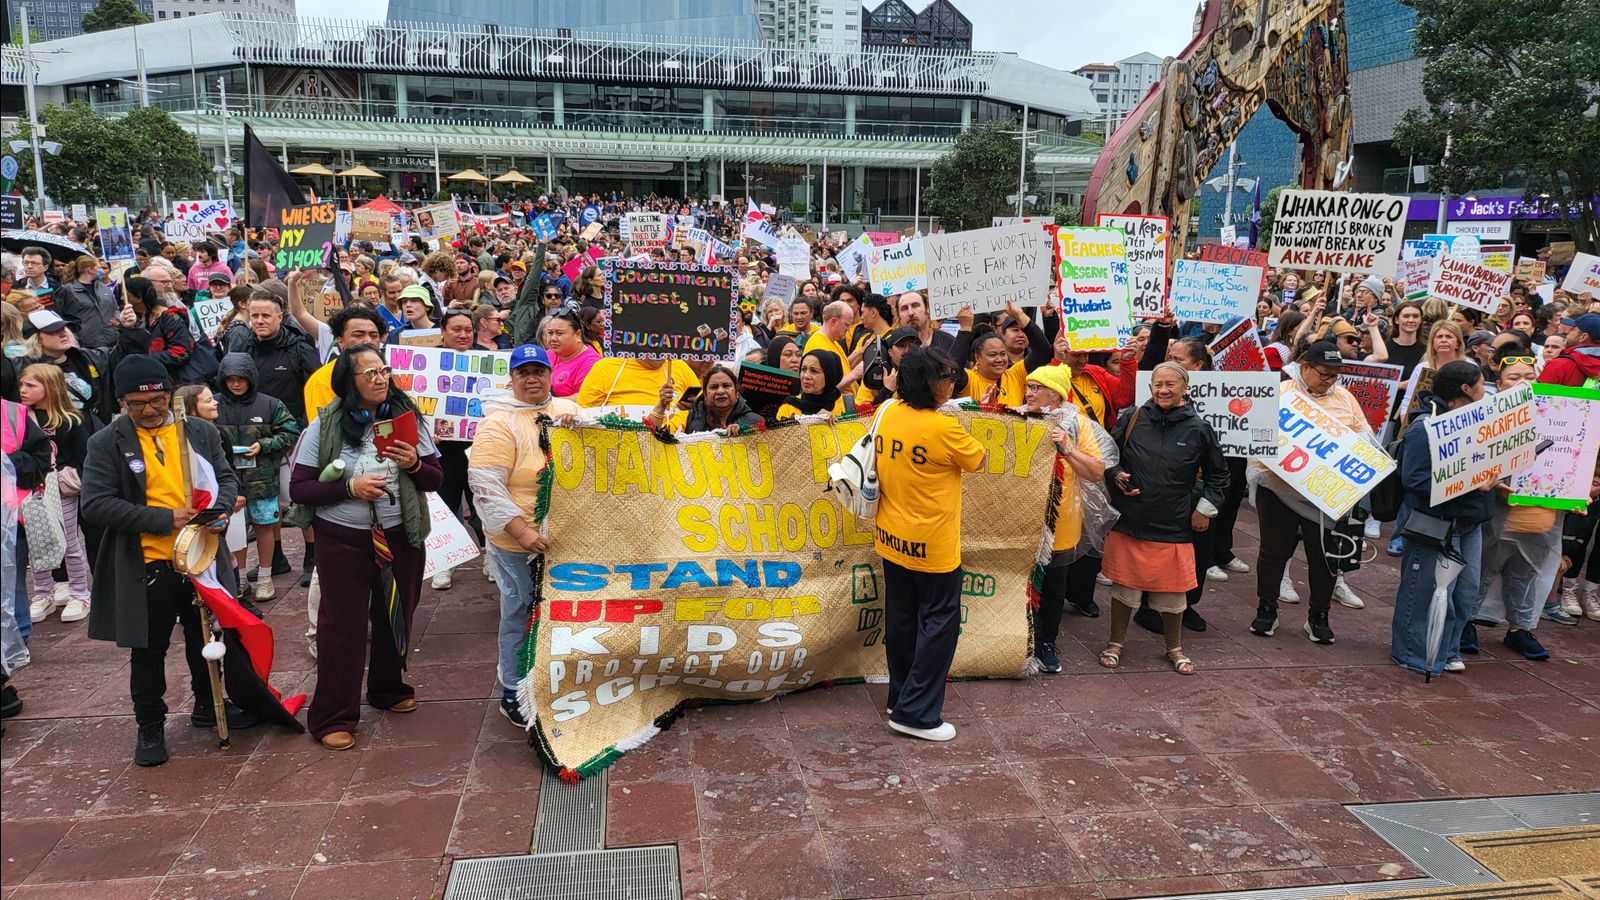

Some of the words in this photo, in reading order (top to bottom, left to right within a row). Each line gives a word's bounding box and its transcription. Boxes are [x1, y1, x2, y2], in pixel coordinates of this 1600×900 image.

[1280, 194, 1404, 222] WHAKARONGO
[1470, 201, 1505, 215] Jack's
[166, 223, 206, 238] LUXON
[280, 228, 305, 248] MY
[631, 232, 649, 240] TIRED
[640, 224, 661, 232] LITTLE
[1274, 220, 1295, 234] THE
[1295, 220, 1333, 235] SYSTEM
[1335, 220, 1346, 235] IS
[1350, 222, 1393, 238] BROKEN
[882, 243, 913, 261] Fund
[990, 231, 1037, 252] WORTH
[1057, 233, 1124, 257] TEACHERS
[1274, 235, 1292, 247] YOU
[1325, 236, 1368, 251] BREAK
[1368, 239, 1386, 254] US
[1406, 240, 1442, 250] TEACHER
[276, 241, 333, 269] $140K?
[984, 256, 1009, 274] FAIR
[1015, 249, 1038, 270] PAY
[1280, 249, 1312, 265] AKE
[1314, 251, 1344, 266] AKE
[1344, 253, 1376, 268] AKE
[611, 268, 731, 290] Government
[870, 262, 926, 284] Education
[1193, 261, 1208, 274] THE
[1210, 263, 1230, 277] TIME
[1232, 265, 1243, 277] I
[1474, 265, 1512, 287] BURNOUT
[932, 280, 971, 298] SAFER
[975, 272, 1029, 292] SCHOOLS
[1073, 283, 1106, 293] because
[1440, 270, 1482, 291] EXPLAINS
[1484, 283, 1503, 298] THIS
[618, 289, 681, 305] invest
[697, 292, 717, 306] in
[986, 286, 1038, 308] FUTURE
[1062, 297, 1112, 315] Students
[1193, 292, 1219, 306] WILL
[200, 301, 228, 317] OUR
[612, 329, 718, 353] EDUCATION
[771, 377, 788, 386] need
[1221, 382, 1275, 398] because
[1341, 376, 1369, 388] When
[1374, 383, 1391, 391] you
[1373, 392, 1384, 400] us
[1289, 393, 1349, 439] TEACHERS
[1431, 406, 1485, 439] TEACHING
[1486, 405, 1494, 415] is
[1498, 387, 1533, 414] CALLING
[1548, 418, 1568, 428] Your
[1438, 437, 1460, 462] NOT
[1465, 435, 1472, 446] a
[1476, 405, 1532, 445] SACRIFICE
[550, 425, 775, 501] OTAHUHU
[1305, 433, 1339, 460] WE
[1333, 453, 1377, 485] NEED
[1432, 457, 1467, 484] VALUE
[1471, 450, 1486, 464] the
[1487, 426, 1537, 460] TEACHERS
[1278, 444, 1310, 473] TO
[1300, 464, 1365, 516] REACH
[1444, 481, 1464, 498] WHO
[1469, 463, 1503, 489] ANSWER
[676, 498, 875, 554] SCHOOL
[548, 559, 802, 592] STAND
[549, 599, 664, 623] UP
[674, 594, 821, 622] FOR
[550, 621, 803, 656] KIDS
[550, 654, 724, 694] PROTECT
[748, 647, 808, 674] OUR
[550, 669, 815, 723] SCHOOLS
